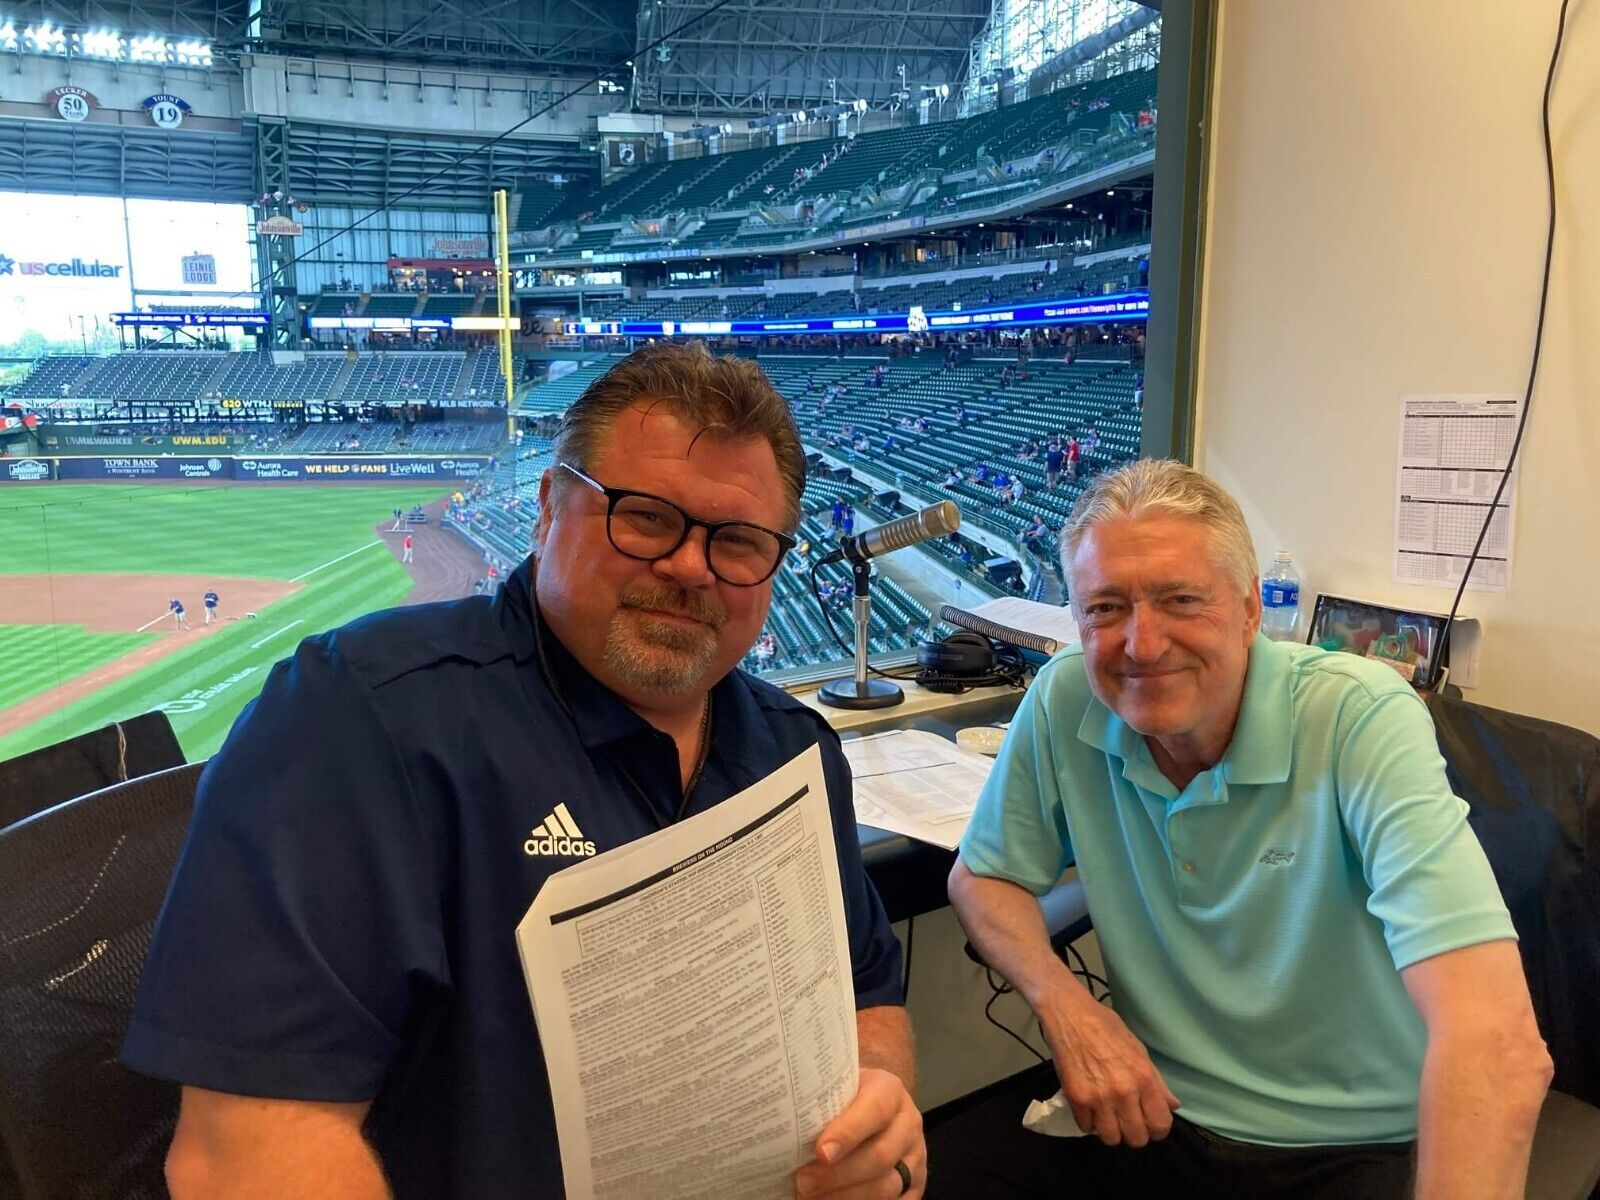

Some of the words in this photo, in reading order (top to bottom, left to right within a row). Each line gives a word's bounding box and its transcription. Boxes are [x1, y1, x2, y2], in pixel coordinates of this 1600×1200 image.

[55, 88, 87, 97] UECKER
[64, 98, 82, 110] 50
[152, 95, 179, 104] YOUNT
[158, 107, 178, 121] 19
[19, 258, 124, 277] uscellular
[184, 262, 213, 271] LEINIE
[185, 272, 214, 281] LODGE
[222, 400, 241, 408] 620
[242, 400, 272, 408] WTMJ
[439, 400, 457, 408] MLB
[172, 436, 227, 445] UWM.EDU
[103, 459, 131, 467] TOWN
[132, 459, 159, 468] BANK
[456, 461, 480, 469] Aurora
[257, 469, 280, 477] Health
[281, 469, 299, 477] Care
[304, 464, 322, 473] WE
[324, 464, 350, 473] HELP
[360, 465, 388, 473] FANS
[524, 835, 597, 856] adidas
[672, 856, 698, 873] BREWERS
[697, 852, 706, 860] ON
[705, 846, 716, 856] THE
[715, 836, 733, 851] MOUND
